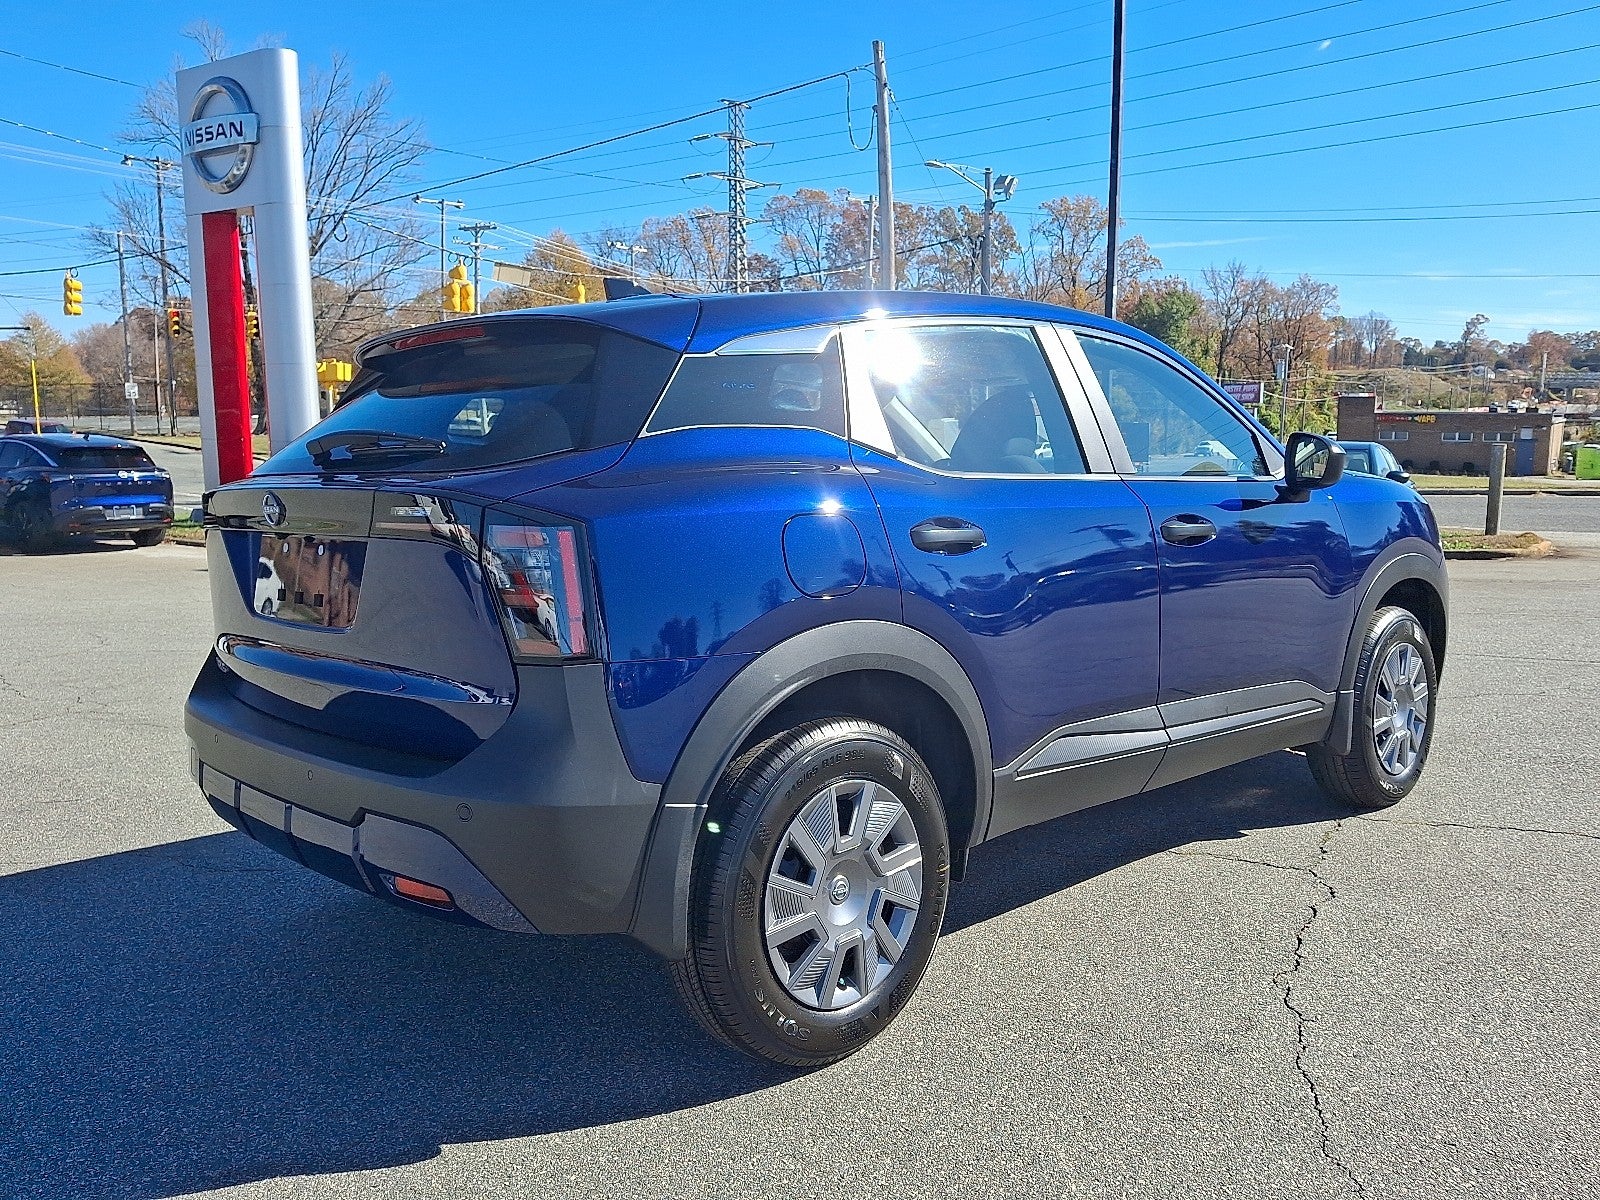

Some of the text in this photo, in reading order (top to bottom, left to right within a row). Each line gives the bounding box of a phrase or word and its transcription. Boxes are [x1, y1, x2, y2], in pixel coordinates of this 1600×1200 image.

[185, 120, 244, 147] NISSAN
[928, 842, 947, 936] KUMHO
[753, 986, 812, 1041] SOLUS
